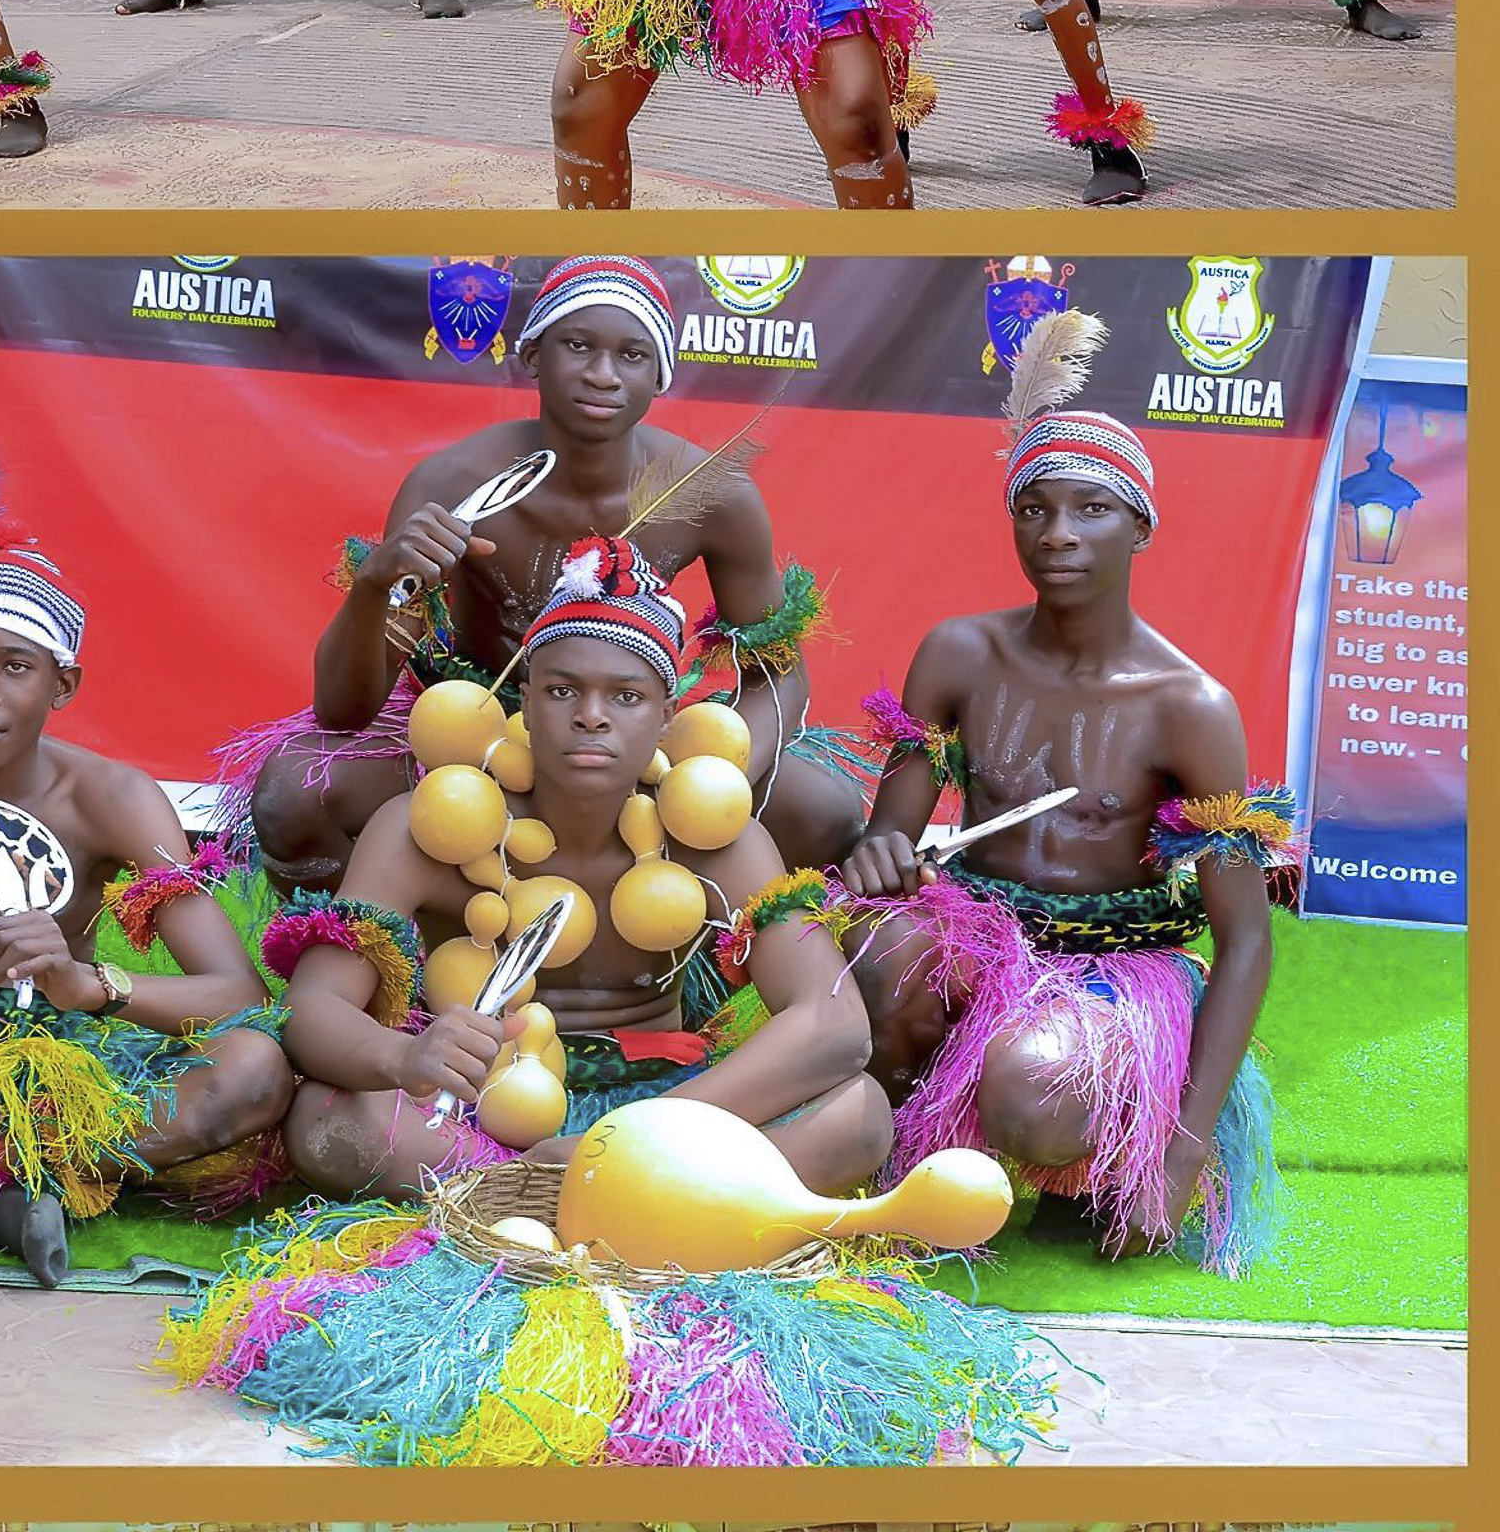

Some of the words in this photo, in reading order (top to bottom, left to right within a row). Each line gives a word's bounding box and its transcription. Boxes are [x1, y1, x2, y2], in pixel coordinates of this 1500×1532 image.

[1200, 267, 1250, 279] AUSTICA
[132, 269, 276, 318] AUSTICA
[132, 308, 187, 321] FOUNDERS'
[188, 312, 209, 323] DAY
[209, 314, 276, 328] CELEBRATION
[678, 313, 817, 359] AUSTICA
[678, 351, 731, 364] FOUNDERS'
[732, 355, 753, 365] DAY
[753, 357, 817, 369] CELEBRATION
[1147, 373, 1284, 418] AUSTICA
[1147, 410, 1200, 422] FOUNDERS'
[1202, 415, 1221, 424] DAY
[1221, 416, 1285, 428] CELEBRATION
[1335, 573, 1414, 596] Take
[1335, 607, 1465, 637] student,
[1337, 636, 1385, 664] big
[1395, 642, 1426, 662] to
[1328, 673, 1418, 693] never
[1427, 676, 1468, 697] kn
[1348, 703, 1379, 723] to
[1389, 705, 1468, 729] learn
[1340, 738, 1416, 758] new.
[1312, 856, 1458, 885] Welcome
